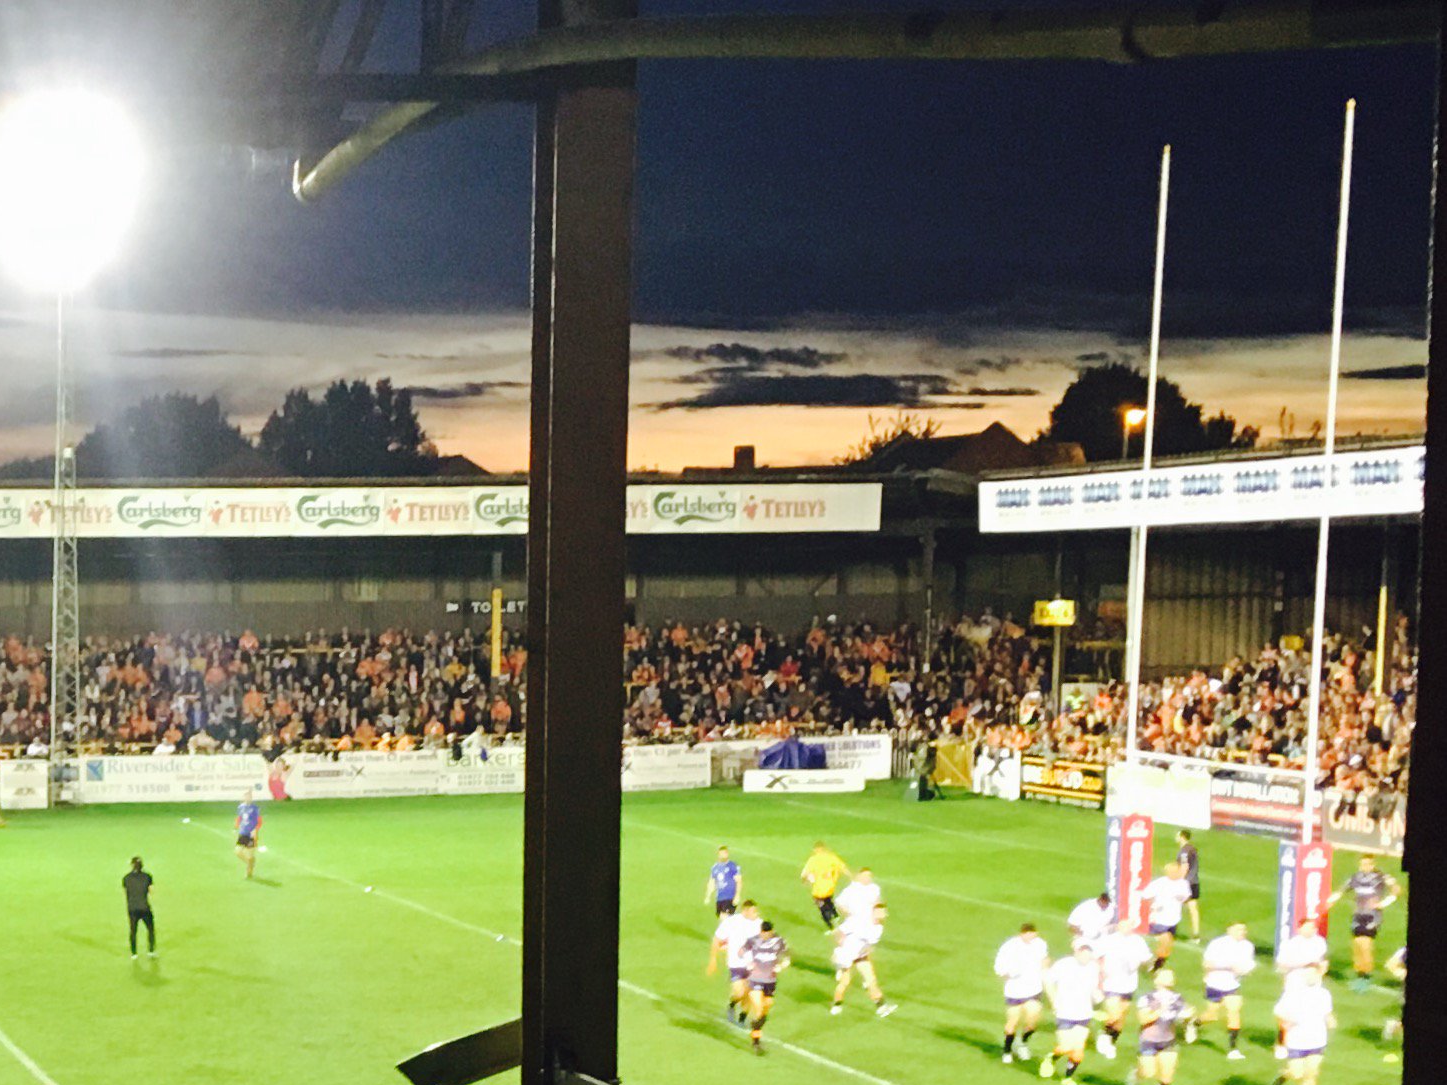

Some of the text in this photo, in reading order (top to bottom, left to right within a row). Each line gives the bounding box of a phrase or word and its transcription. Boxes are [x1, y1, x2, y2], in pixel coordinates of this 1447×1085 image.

[117, 496, 202, 530] Carlsberg
[296, 494, 380, 529] Carlsberg
[653, 491, 736, 525] Carlsberg
[470, 600, 527, 614] TOET
[107, 759, 185, 774] Riverside
